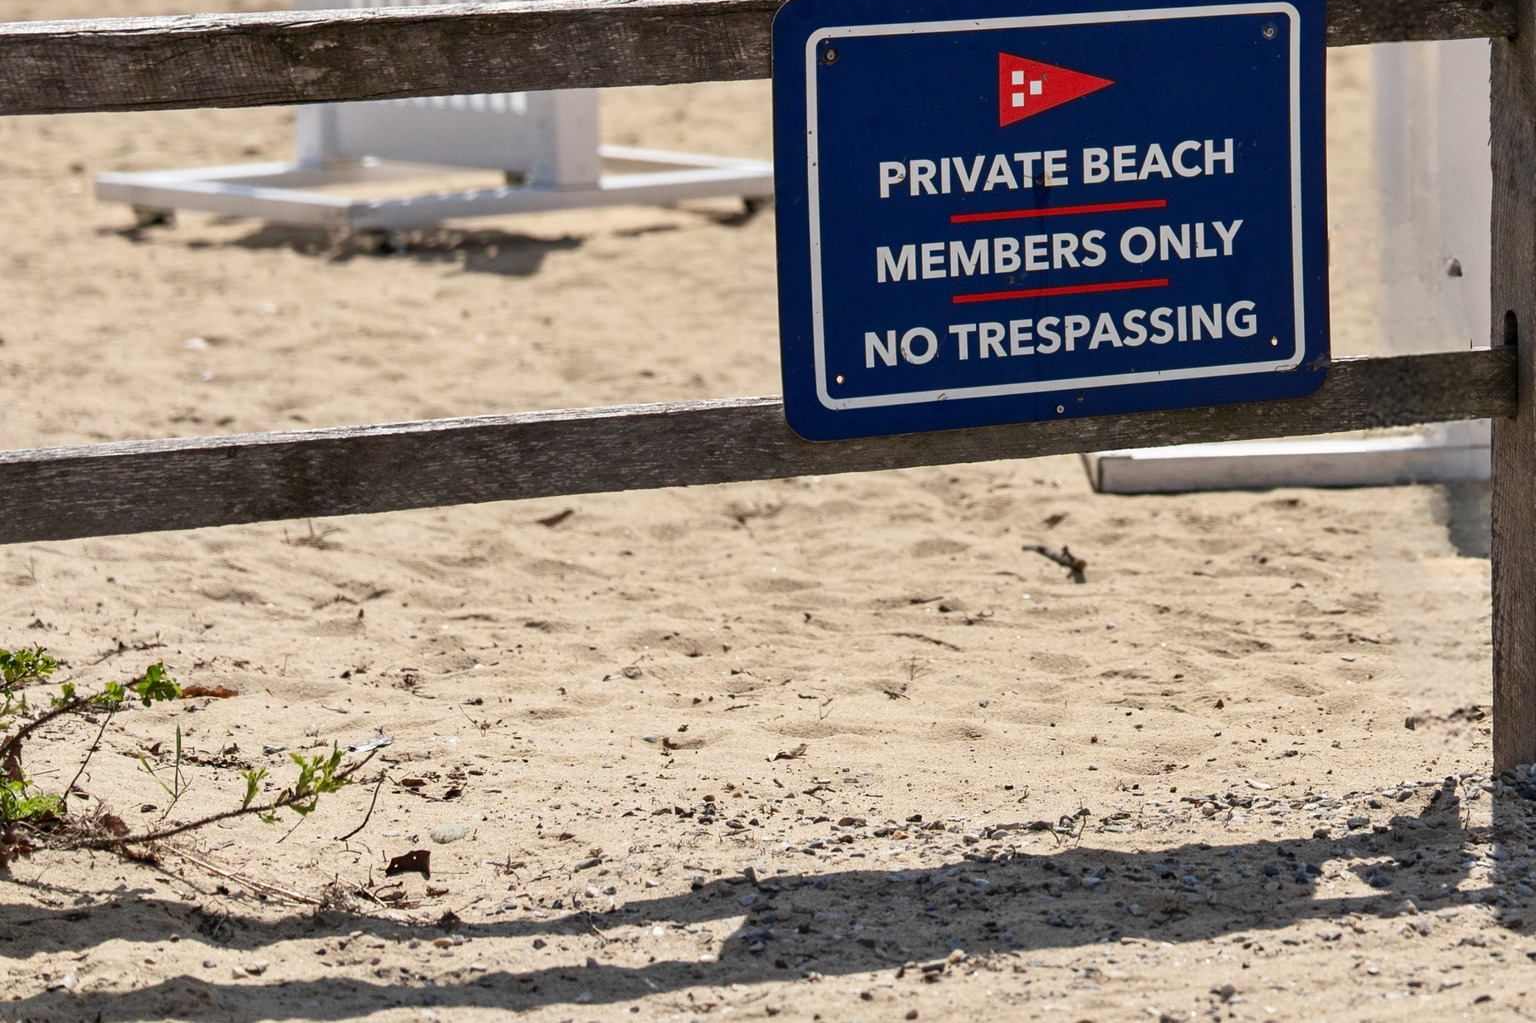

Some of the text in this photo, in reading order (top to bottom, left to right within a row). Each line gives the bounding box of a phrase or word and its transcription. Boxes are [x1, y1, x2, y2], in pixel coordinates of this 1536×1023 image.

[879, 138, 1235, 199] PRIVATE BEACH
[876, 219, 1244, 284] MEMBERS ONLY
[864, 300, 1258, 369] NO TRESPASSING
